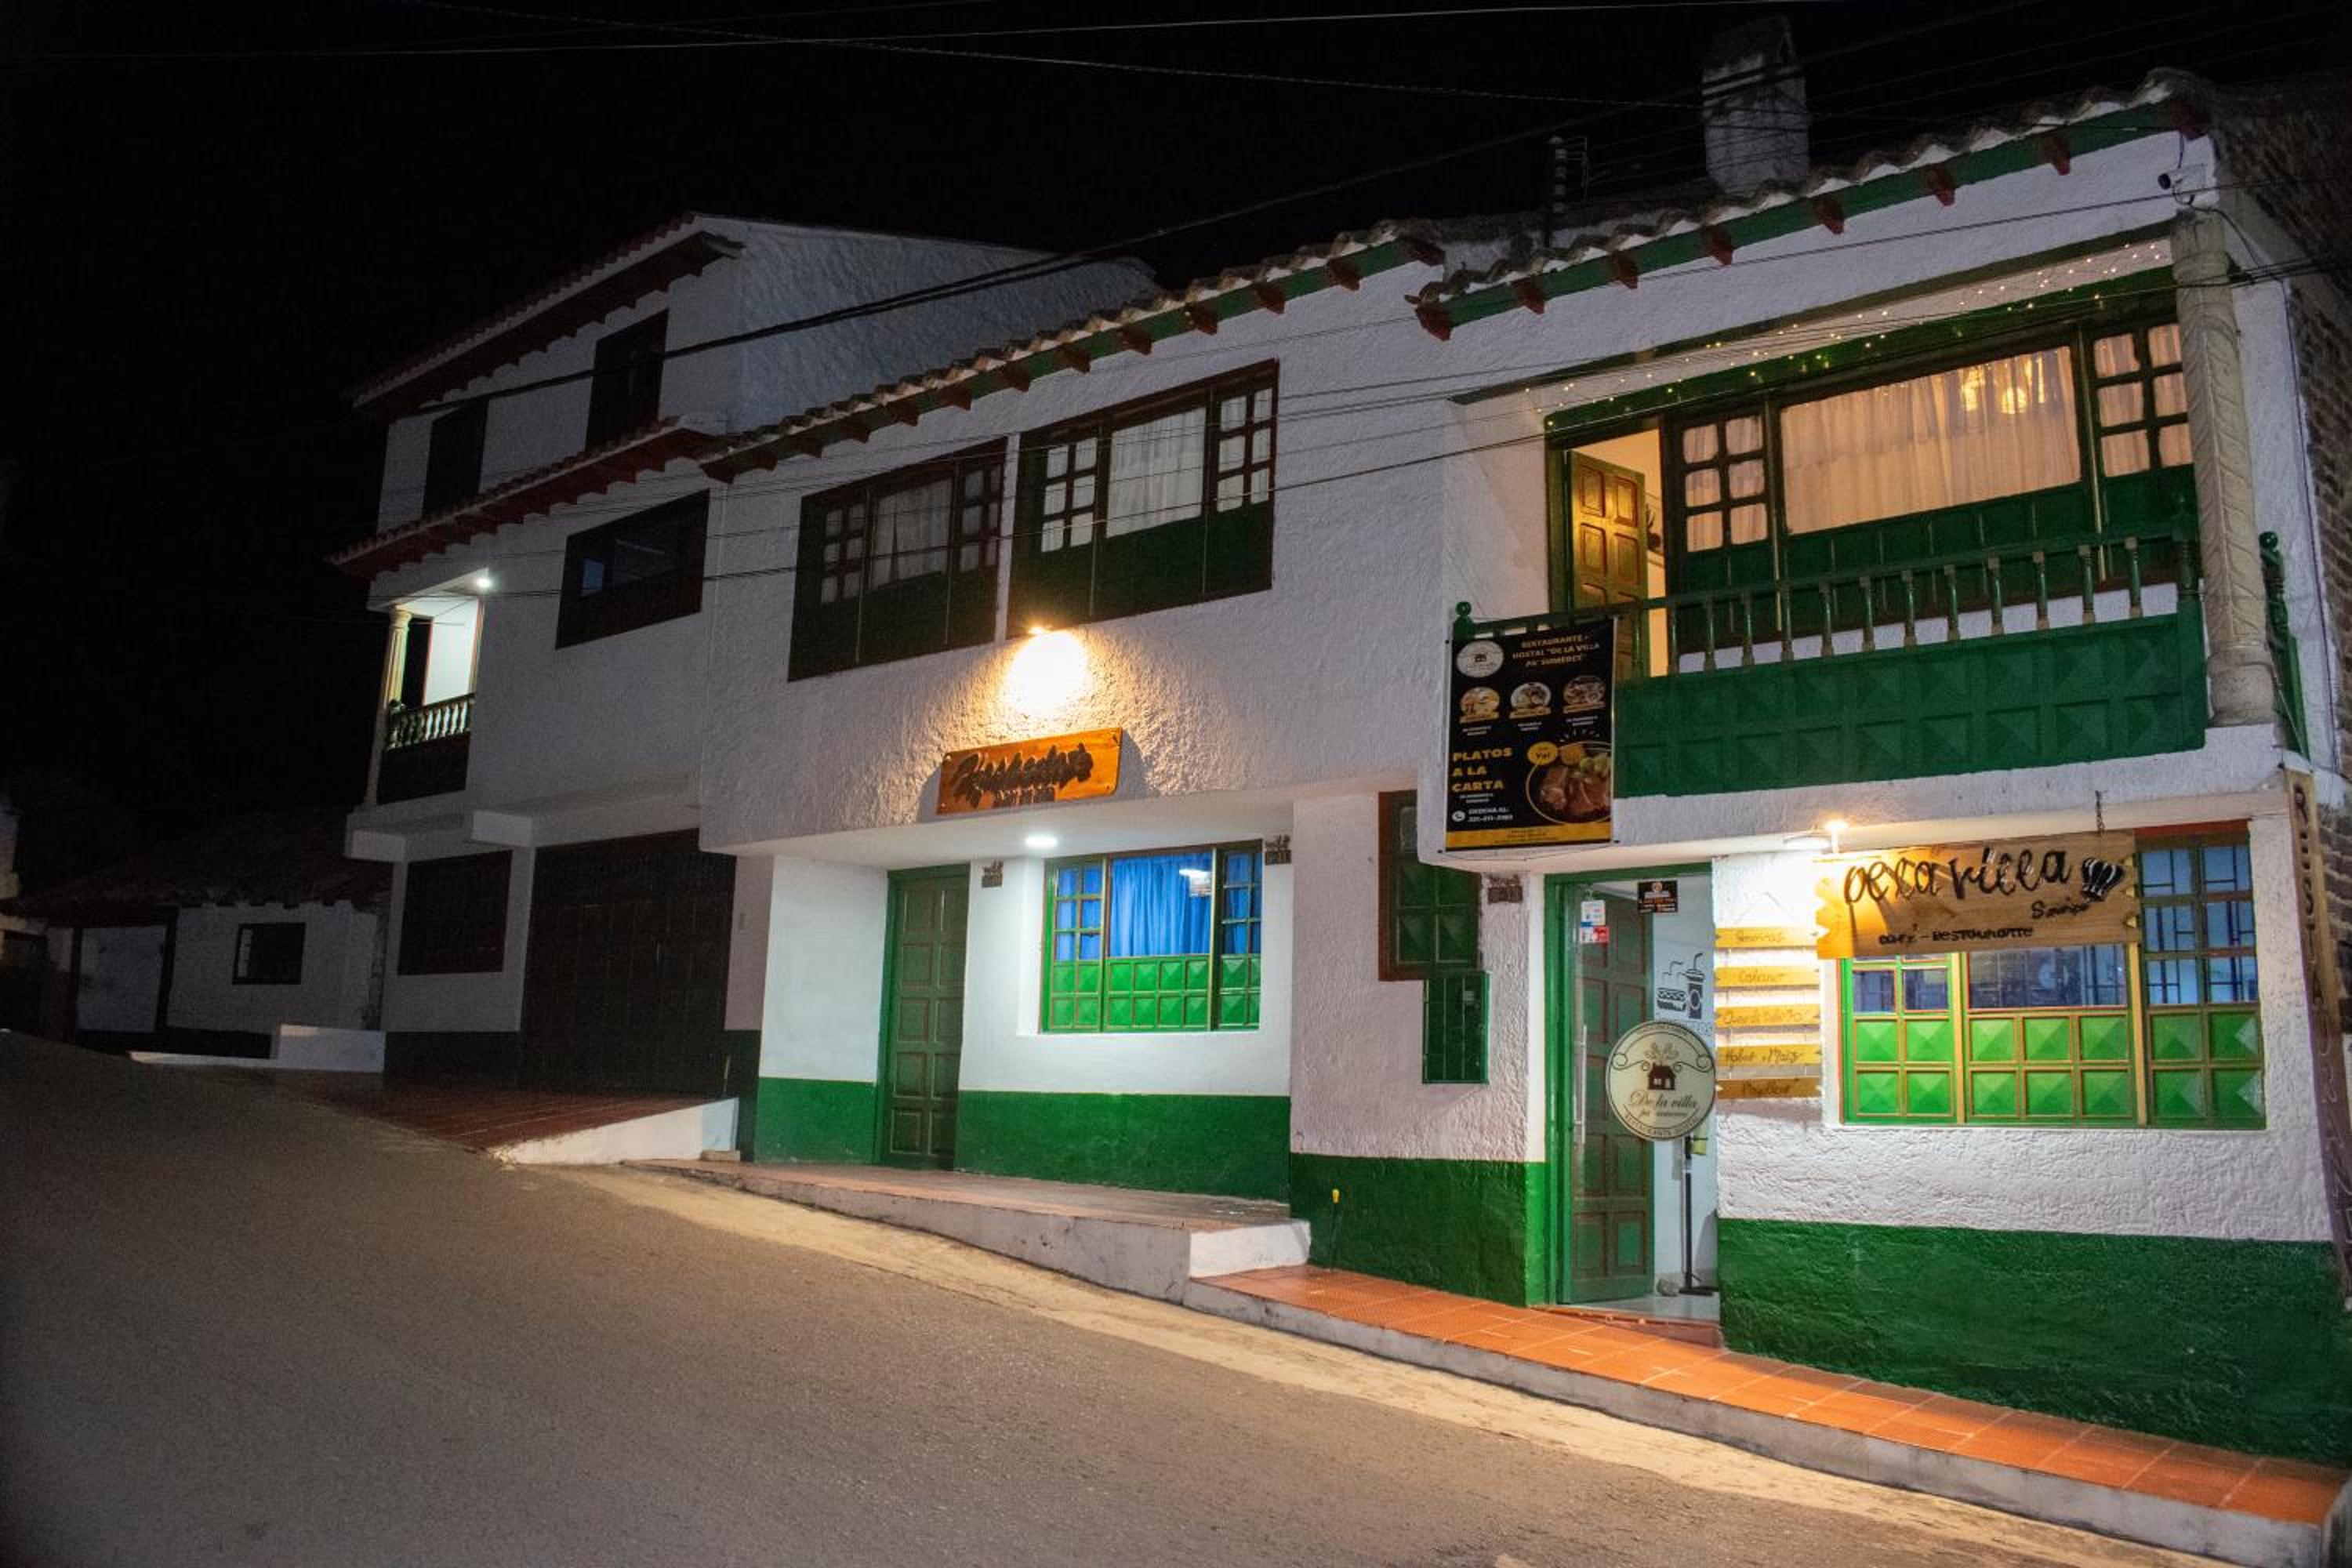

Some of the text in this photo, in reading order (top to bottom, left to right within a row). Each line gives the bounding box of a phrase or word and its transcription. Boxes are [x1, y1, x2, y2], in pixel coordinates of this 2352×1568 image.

[1453, 747, 1512, 762] PLATOS
[1453, 766, 1487, 776] A LA
[1451, 780, 1504, 793] CARTA
